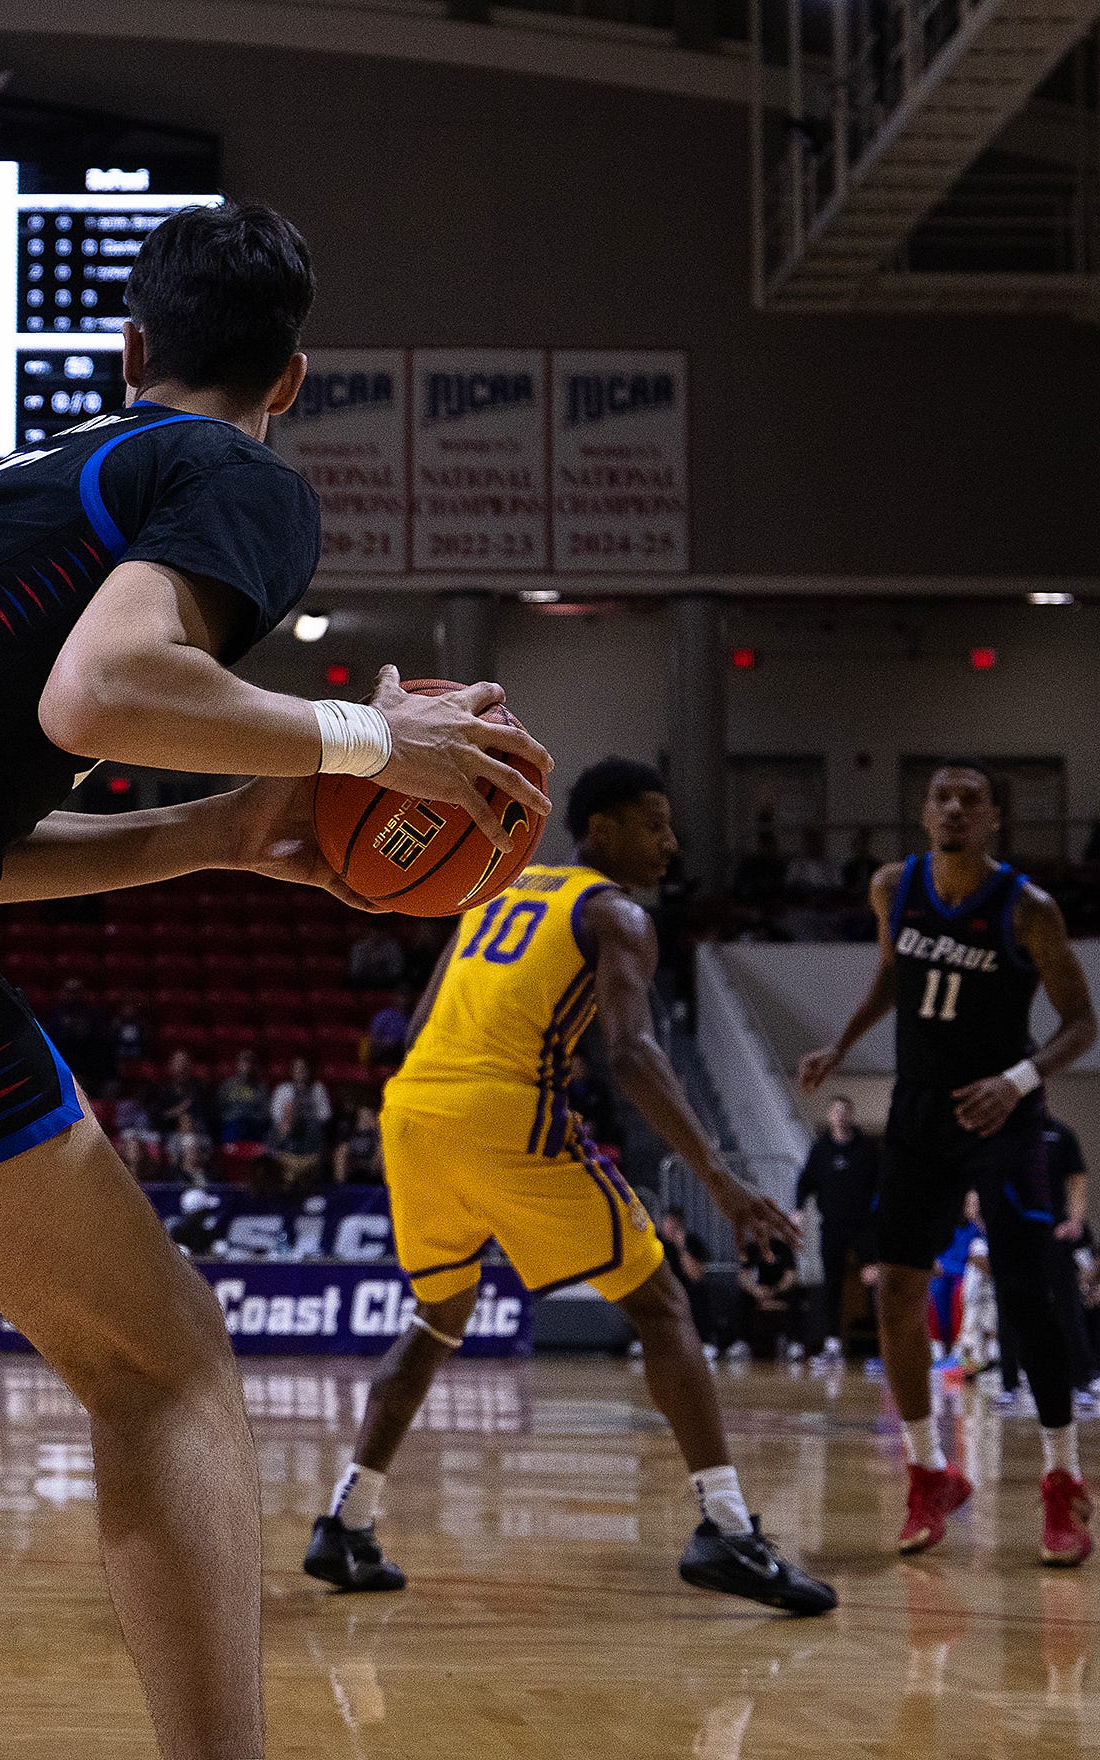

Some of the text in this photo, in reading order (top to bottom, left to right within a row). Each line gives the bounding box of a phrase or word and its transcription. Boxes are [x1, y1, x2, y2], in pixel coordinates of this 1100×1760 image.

[322, 531, 392, 556] 20-21
[460, 896, 548, 965] 10
[918, 968, 962, 1021] 11
[215, 1278, 341, 1336] Coast
